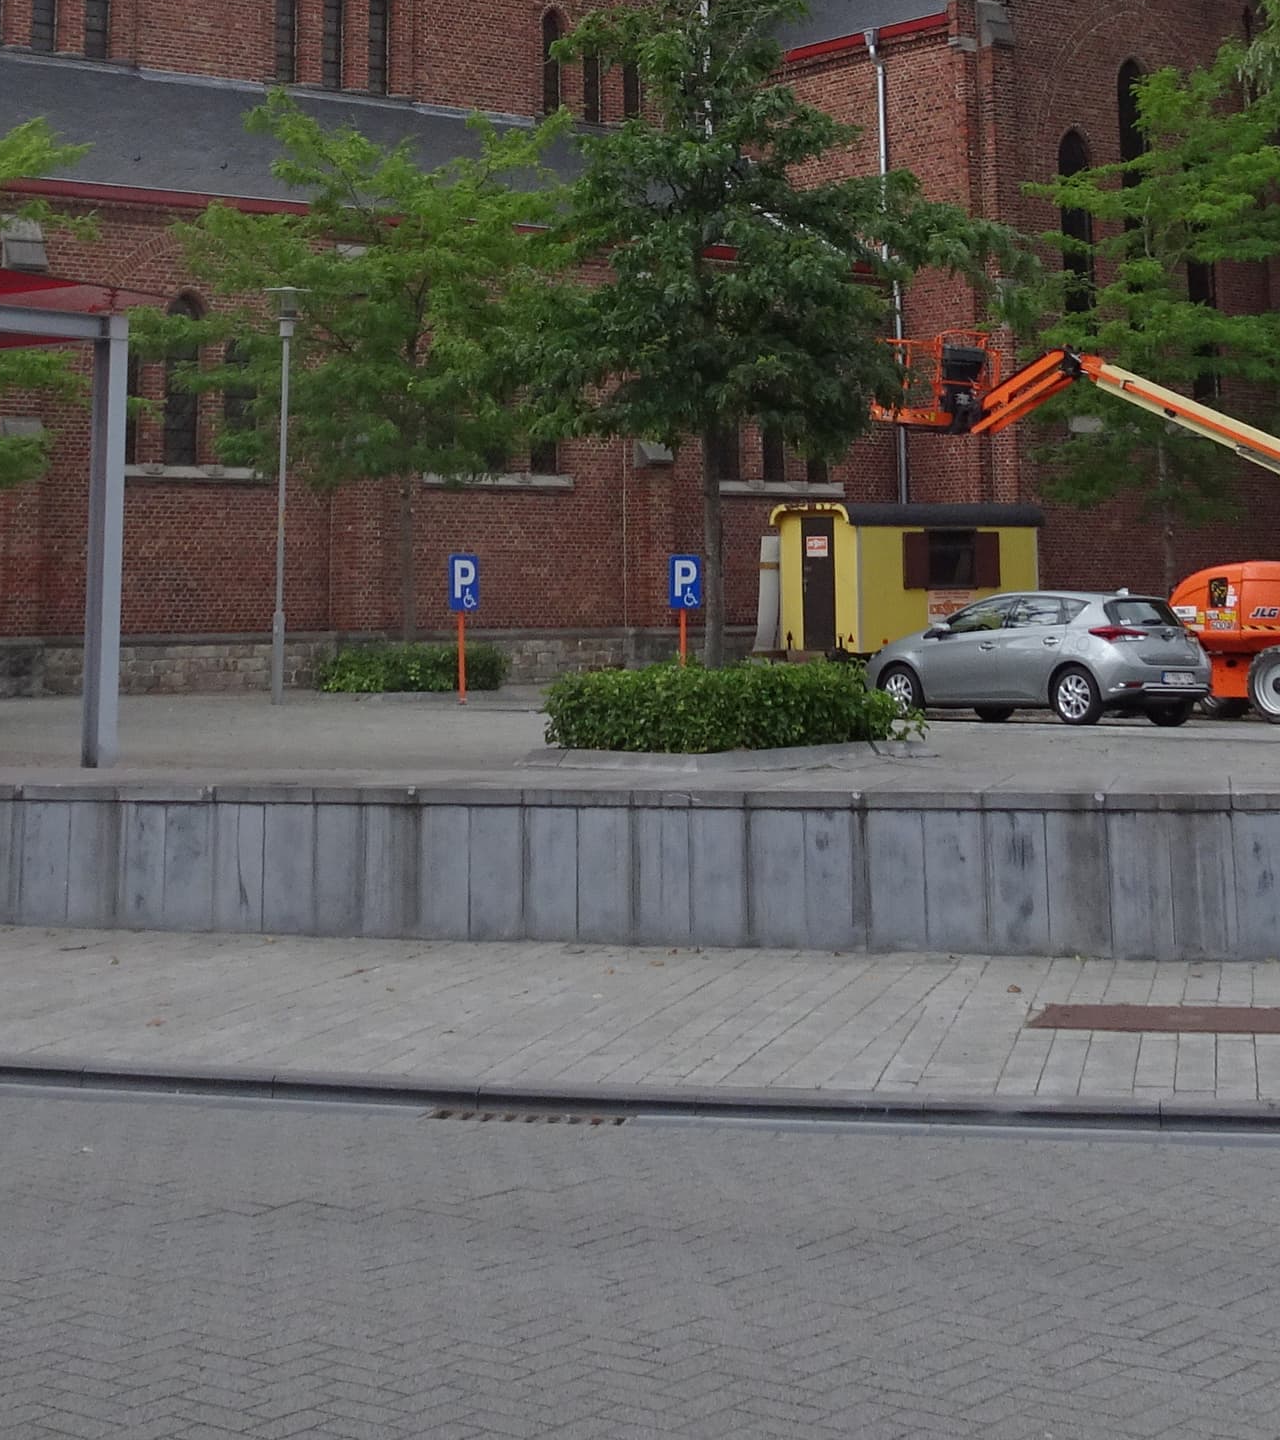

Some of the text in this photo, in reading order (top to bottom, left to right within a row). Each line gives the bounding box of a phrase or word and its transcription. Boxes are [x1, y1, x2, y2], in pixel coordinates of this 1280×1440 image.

[455, 560, 475, 598] P
[675, 560, 696, 597] P
[1251, 607, 1280, 618] JLG
